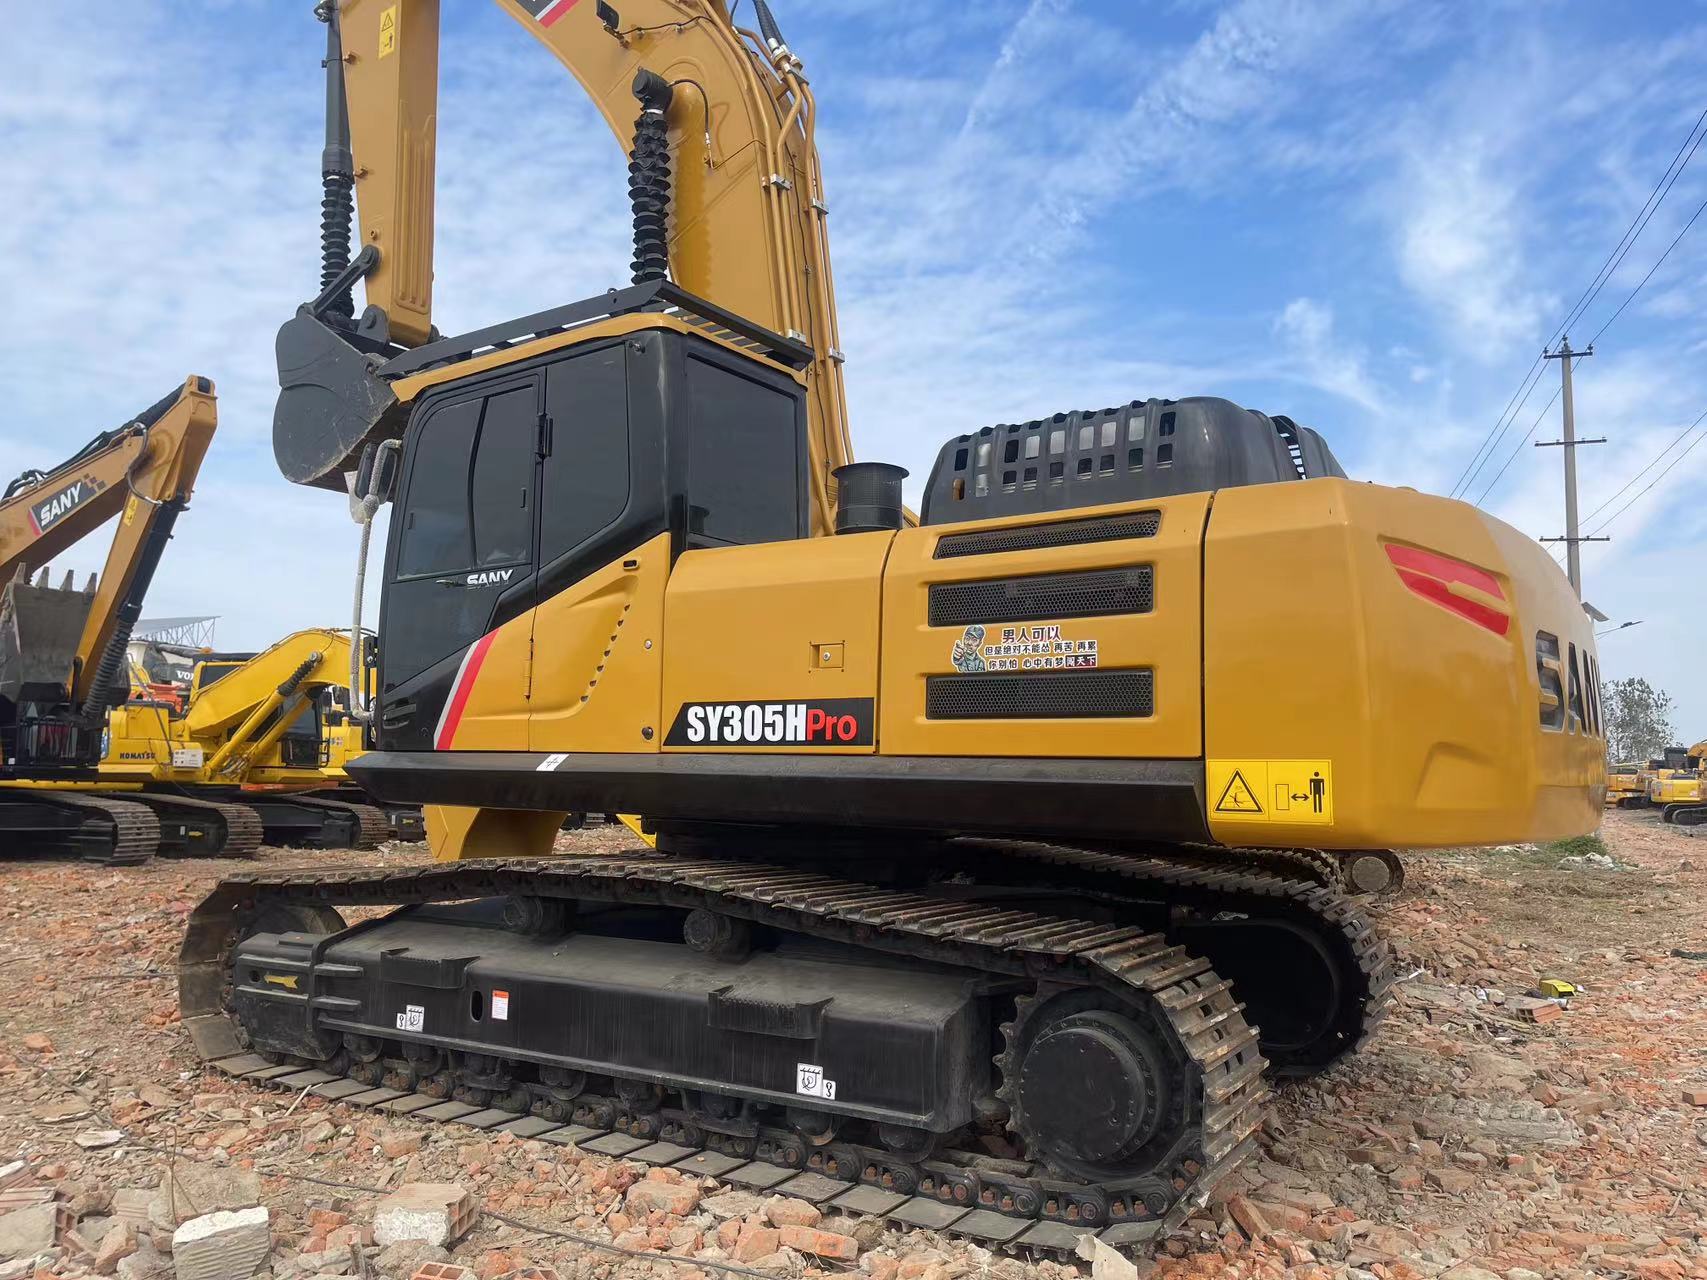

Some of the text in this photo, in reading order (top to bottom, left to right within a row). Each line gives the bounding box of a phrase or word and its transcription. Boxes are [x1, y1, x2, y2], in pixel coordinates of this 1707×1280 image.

[40, 482, 82, 527] SANY
[466, 569, 514, 585] SANY
[1002, 626, 1062, 643] 男人可以
[985, 640, 1096, 656] 但是绝对不能怂 再苦 再累
[988, 658, 1018, 670] 你别怕
